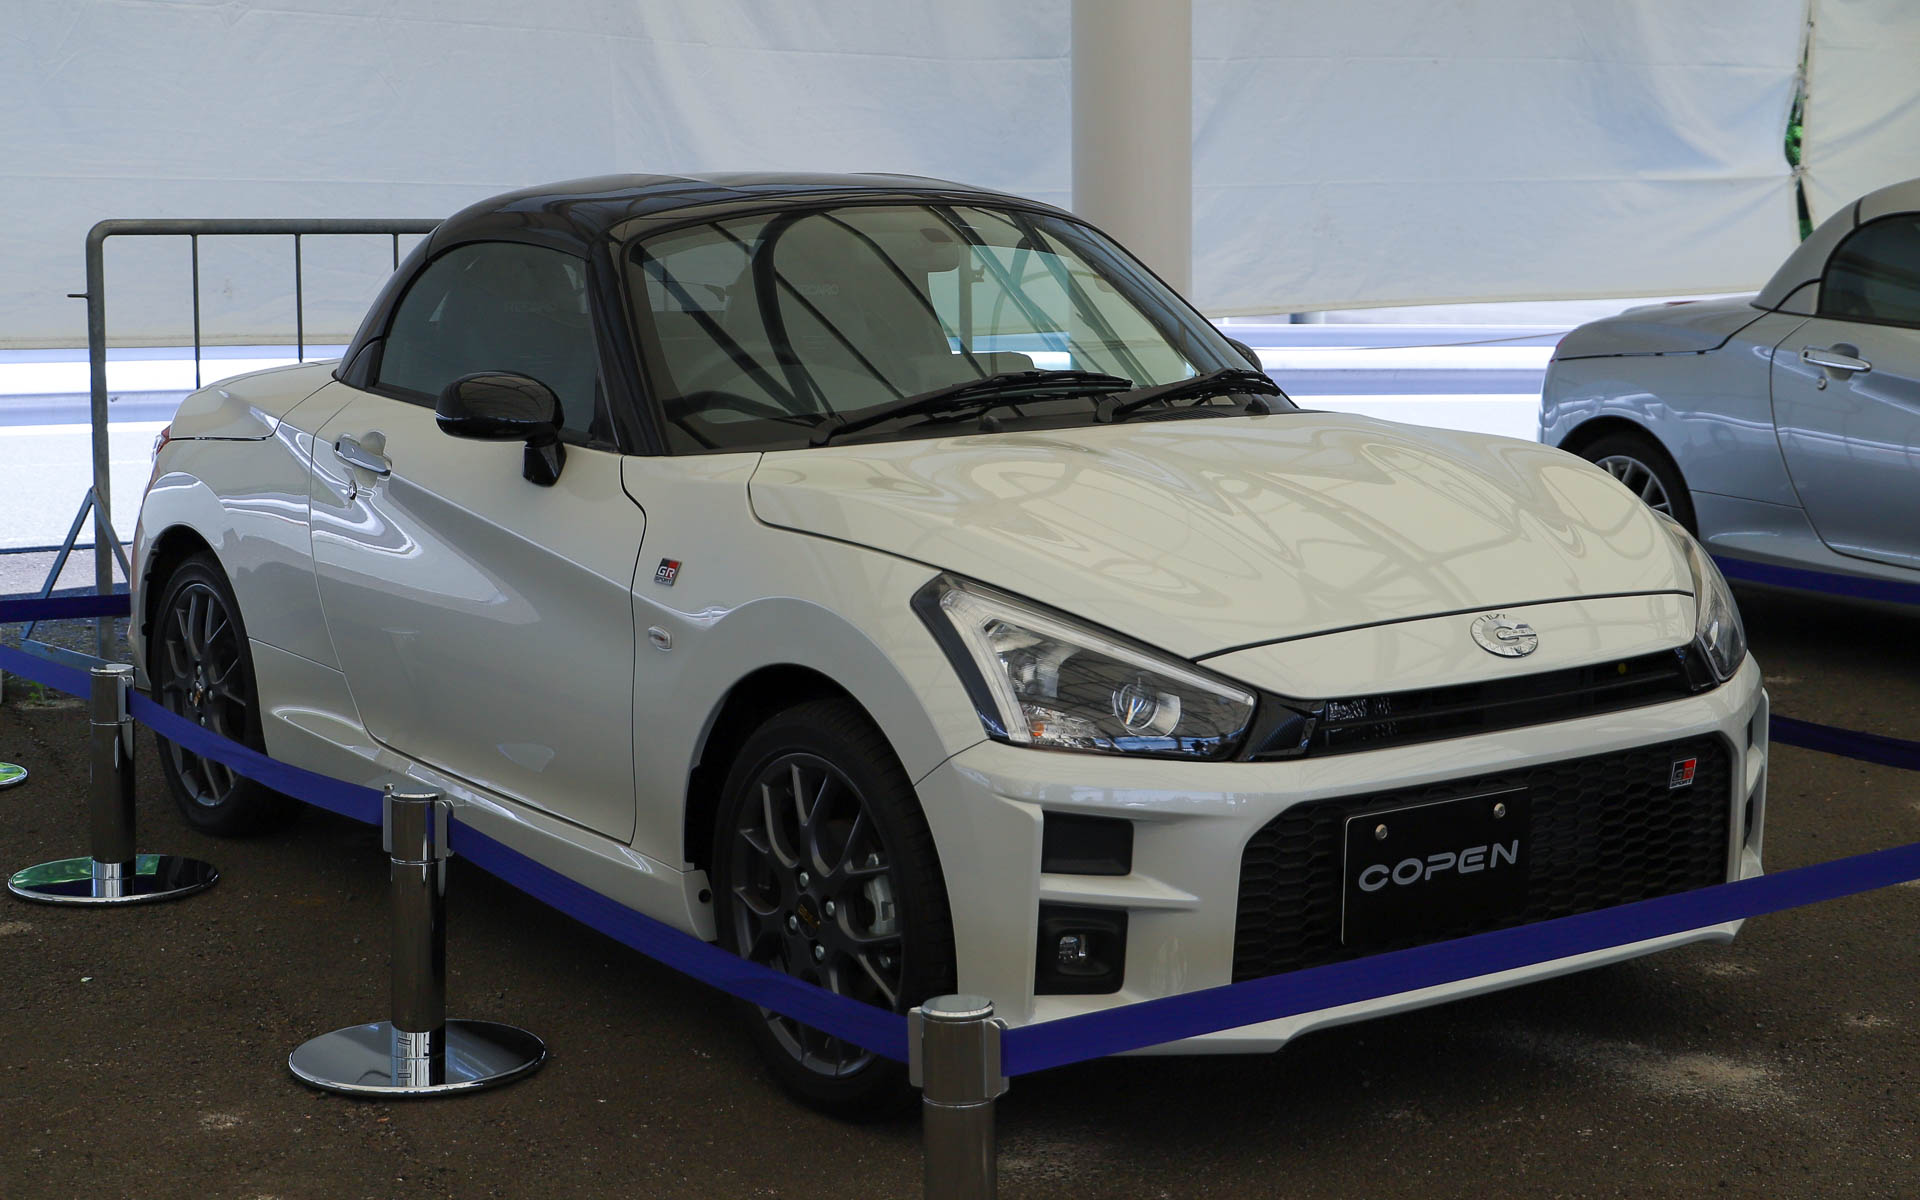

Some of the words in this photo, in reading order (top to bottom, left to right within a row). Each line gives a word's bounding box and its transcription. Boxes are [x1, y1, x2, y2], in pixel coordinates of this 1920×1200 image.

[657, 566, 676, 578] GR
[1672, 767, 1694, 780] GR
[1358, 839, 1519, 892] COPEN
